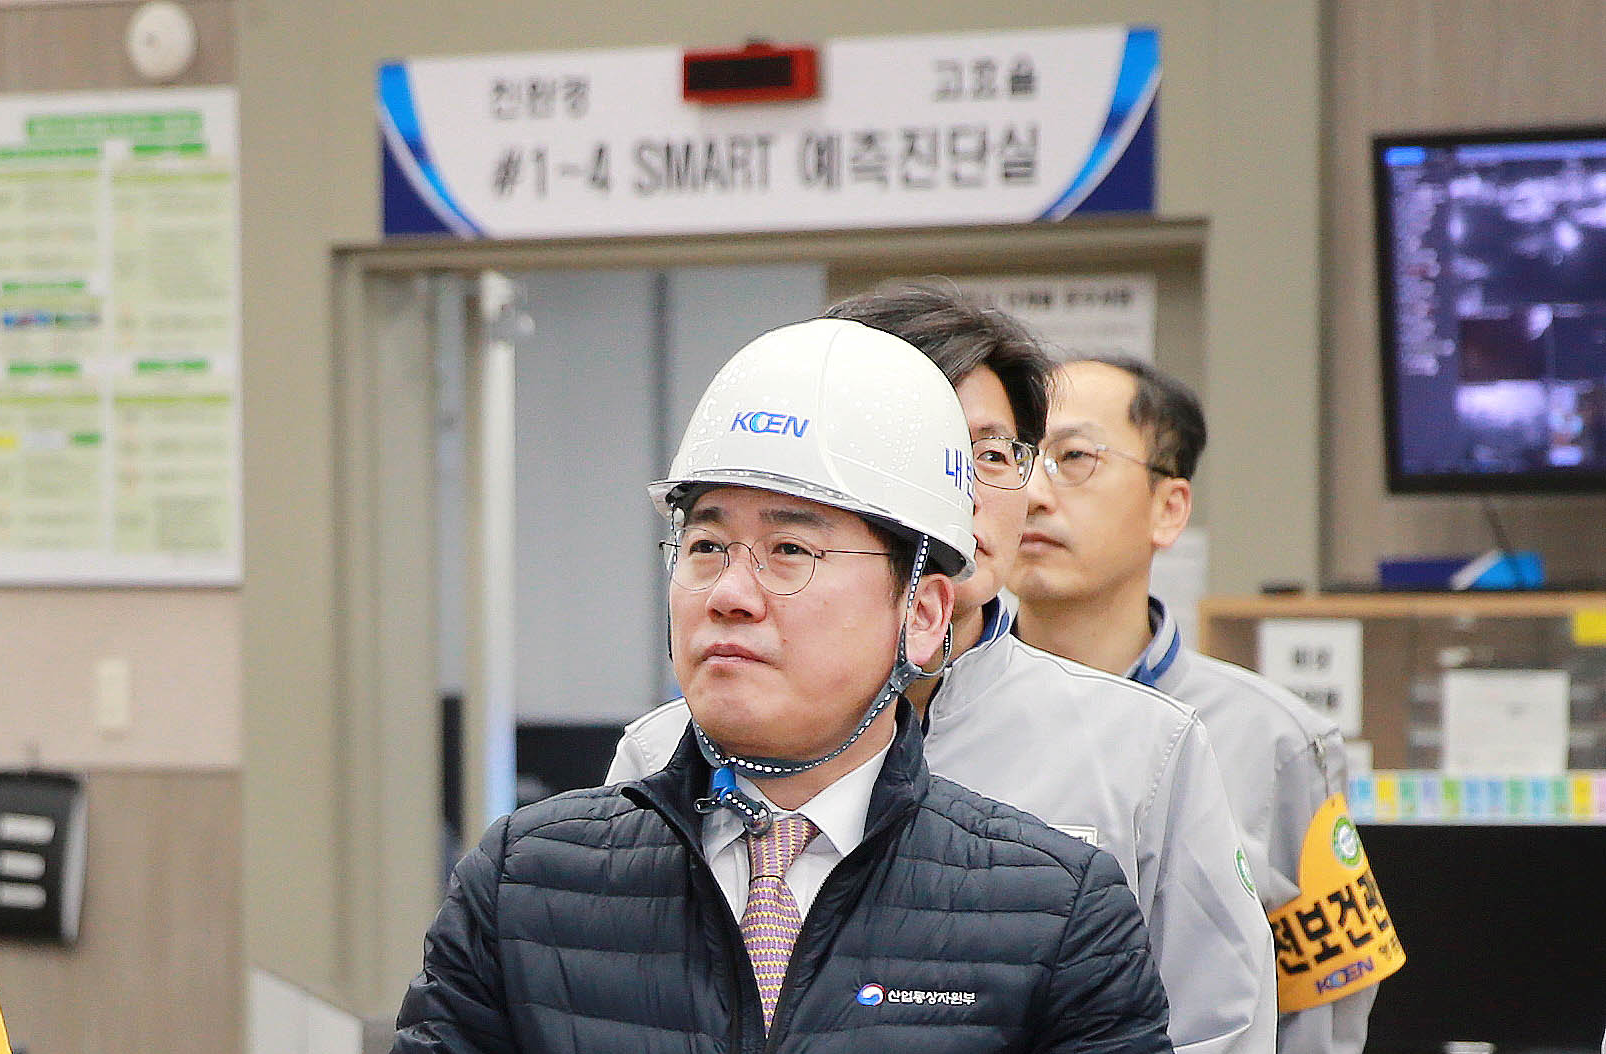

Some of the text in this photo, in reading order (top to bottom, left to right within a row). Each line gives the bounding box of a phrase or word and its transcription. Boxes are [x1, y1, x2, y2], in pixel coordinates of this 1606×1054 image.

[934, 55, 1036, 101] 고효율
[492, 123, 1041, 198] #1-4 SMART 예측진단실
[887, 988, 977, 1006] 산업통상자원부
